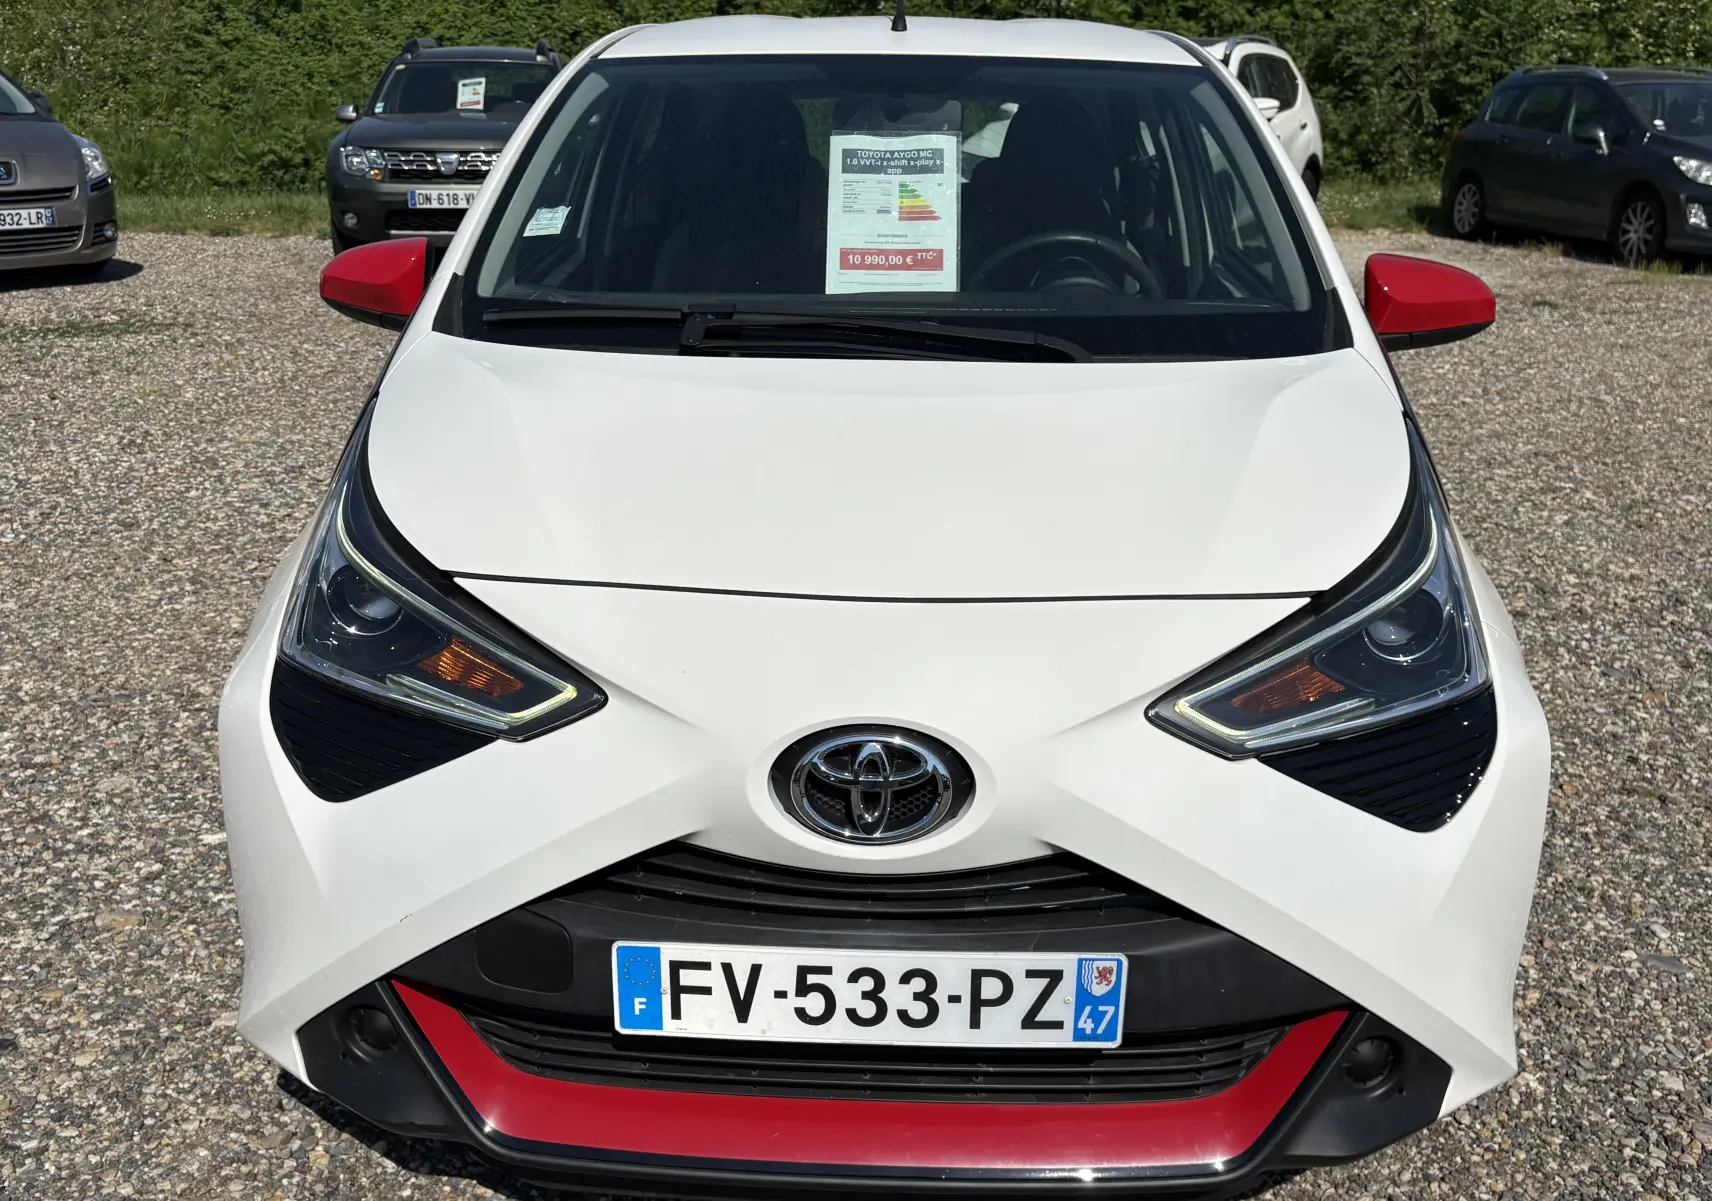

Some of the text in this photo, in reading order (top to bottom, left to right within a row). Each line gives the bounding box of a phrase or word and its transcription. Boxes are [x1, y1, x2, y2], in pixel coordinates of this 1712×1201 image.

[857, 150, 933, 159] TOYOTA AYGO MC
[882, 158, 908, 167] x-shift
[909, 158, 934, 168] x-play
[886, 167, 903, 175] app
[847, 254, 861, 264] 10
[864, 255, 903, 267] 990,00
[906, 255, 914, 265] €
[669, 960, 1064, 1030] FV-533-PZ
[634, 997, 647, 1015] F
[1077, 1005, 1115, 1034] 47
